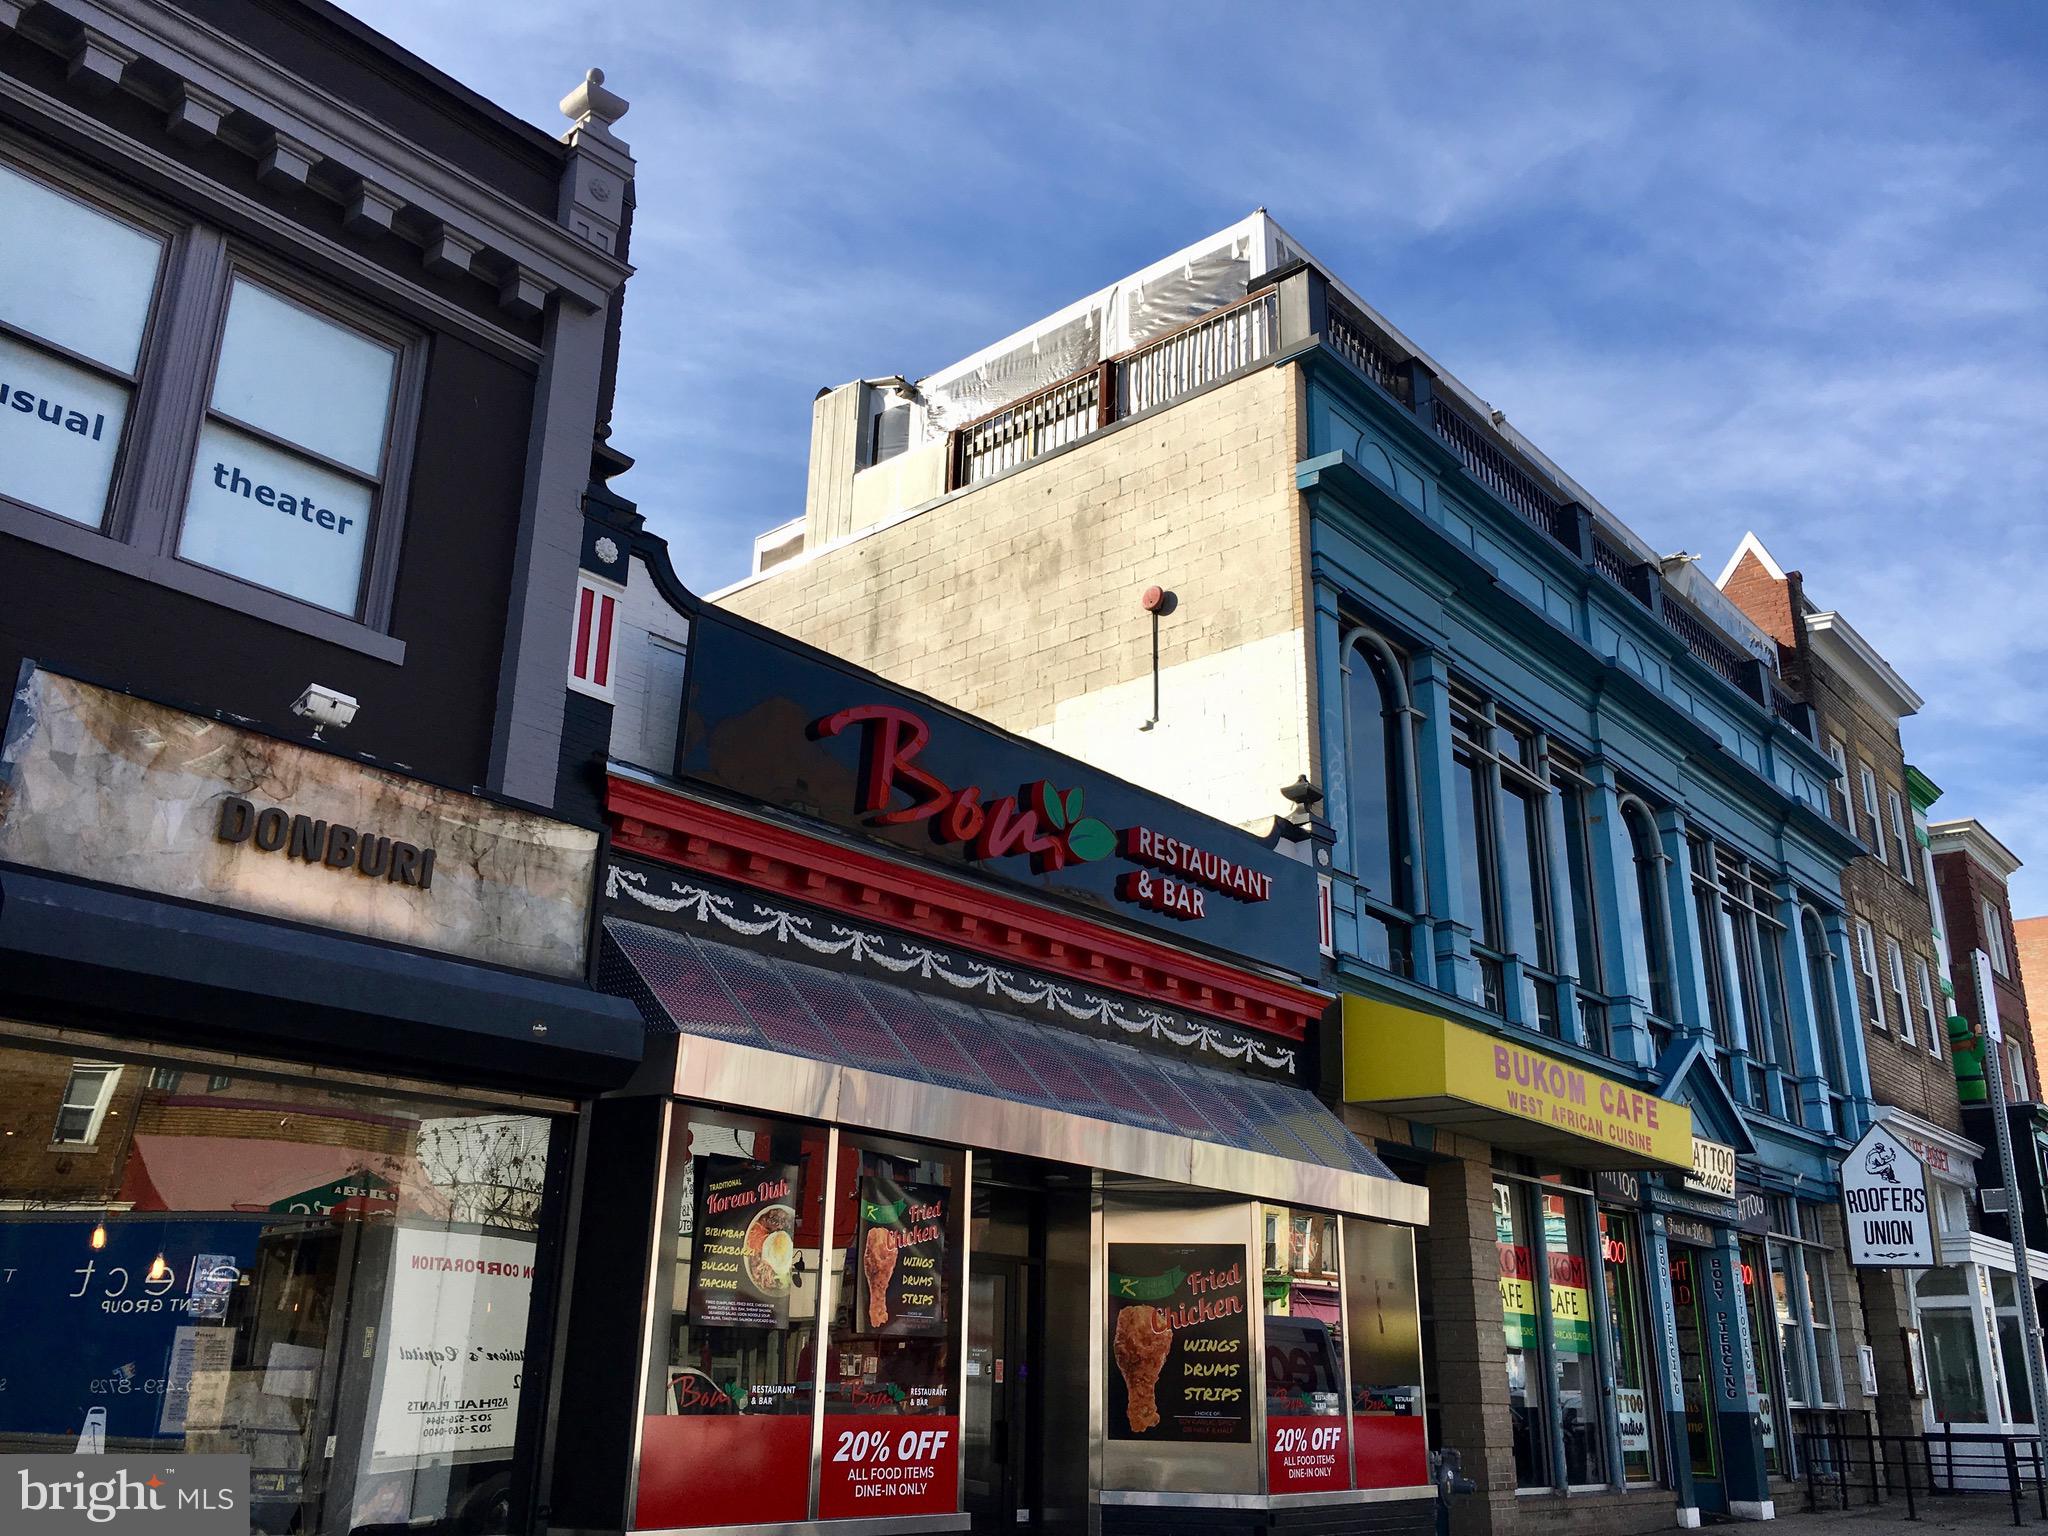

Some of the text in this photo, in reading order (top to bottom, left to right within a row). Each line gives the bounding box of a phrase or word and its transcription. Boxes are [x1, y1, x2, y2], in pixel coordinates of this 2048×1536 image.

[213, 462, 354, 535] theater
[218, 796, 437, 888] DONBURI
[1137, 826, 1274, 902] RESTAURANT
[1137, 869, 1206, 918] & BAR
[1493, 1044, 1660, 1130] BUKOM CAFE
[1507, 1090, 1653, 1152] WEST AFRICAN CUISINE
[1692, 1142, 1734, 1177] ATTOO
[709, 1178, 742, 1191] TRADITIONAL
[706, 1179, 791, 1214] Korean Dish
[1738, 1194, 1764, 1221] ATTOO
[1846, 1187, 1925, 1213] ROOFERS
[909, 1200, 942, 1223] Fried
[705, 1227, 745, 1239] BIBIMBAP
[886, 1224, 939, 1252] Chicken
[1863, 1220, 1914, 1245] UNION
[701, 1261, 738, 1272] BULGOGI
[903, 1256, 935, 1268] WINGS
[700, 1278, 738, 1289] JAPCHAE
[902, 1275, 933, 1287] DRUMS
[1186, 1262, 1242, 1295] Fried
[901, 1293, 934, 1305] STRIPS
[1500, 1283, 1523, 1308] AFE
[1150, 1295, 1244, 1334] Chicken
[1657, 1244, 1681, 1395] BODY PIERCING
[1711, 1257, 1737, 1400] BODY PIERCING
[1183, 1339, 1240, 1352] WINGS
[1183, 1363, 1240, 1377] DRUMS
[751, 1385, 796, 1395] RESTAURANT
[751, 1396, 773, 1405] & BAR
[910, 1387, 948, 1397] RESTAURANT
[1184, 1387, 1242, 1401] STRIPS
[909, 1398, 928, 1406] & BAR
[1617, 1394, 1644, 1413] TTOO
[833, 1430, 949, 1463] 20% OFF
[1274, 1428, 1342, 1452] 20% OFF
[1283, 1454, 1336, 1466] ALL FOOD ITEMS
[847, 1467, 934, 1481] ALL FOOD ITEMS
[1288, 1467, 1332, 1479] DINE-IN ONLY
[855, 1483, 928, 1498] DINE-IN ONLY
